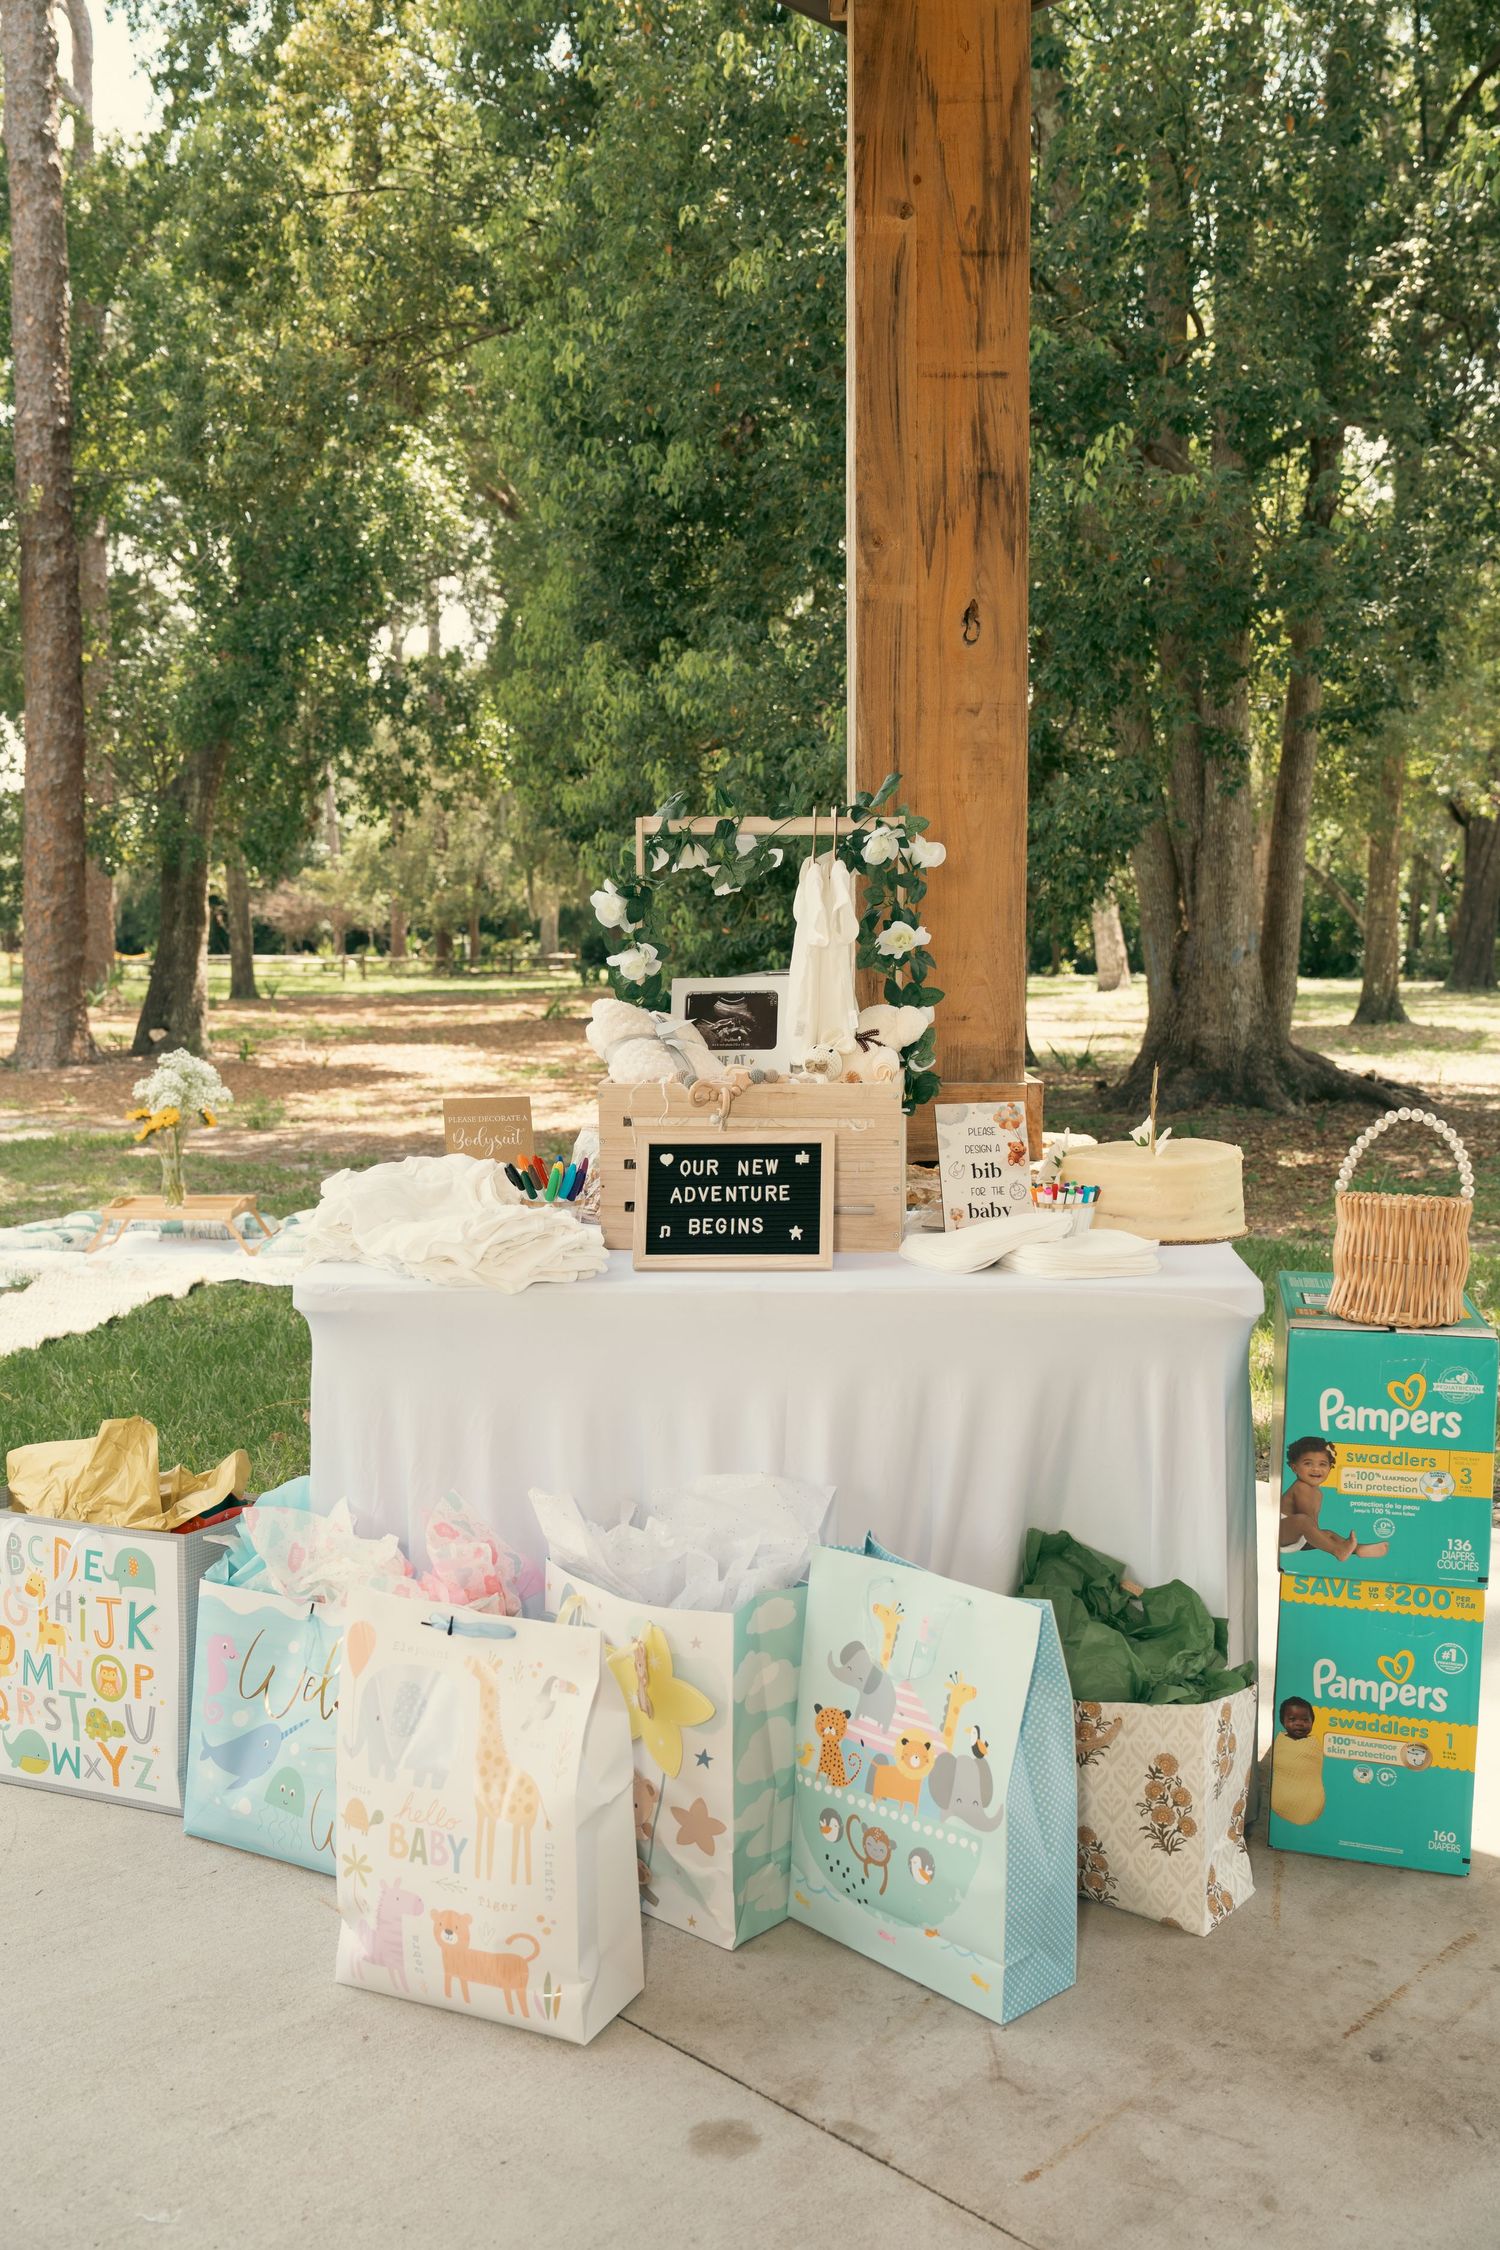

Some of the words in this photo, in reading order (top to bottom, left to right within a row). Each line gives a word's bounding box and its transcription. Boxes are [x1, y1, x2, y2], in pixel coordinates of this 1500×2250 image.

[448, 1115, 477, 1123] PLEASE
[478, 1115, 520, 1123] DECORATE
[967, 1127, 996, 1137] PLEASE
[452, 1125, 526, 1157] Bodysuit
[964, 1145, 992, 1155] DESIGN
[995, 1145, 1000, 1153] A
[679, 1159, 719, 1177] OUR
[737, 1158, 779, 1177] NEW
[971, 1162, 1002, 1179] bib
[669, 1184, 791, 1204] ADVENTURE
[970, 1186, 986, 1197] FOR
[991, 1186, 1005, 1197] THE
[967, 1202, 1012, 1219] baby
[688, 1217, 764, 1236] BEGINS
[1435, 1384, 1482, 1393] PEDIATRICIAN
[1319, 1387, 1463, 1440] Pampers
[1346, 1450, 1437, 1468] swaddlers
[1355, 1470, 1381, 1482] 100%
[1381, 1475, 1418, 1483] LEAKPROOF
[1460, 1468, 1473, 1485] 3
[1343, 1480, 1363, 1490] skin
[1365, 1482, 1418, 1494] protection
[1349, 1500, 1384, 1508] protection
[1447, 1538, 1472, 1551] 136
[1441, 1550, 1476, 1563] DIAPERS
[1436, 1559, 1480, 1572] COUCHES
[1293, 1575, 1362, 1601] SAVE
[1368, 1592, 1379, 1600] TO
[1455, 1595, 1471, 1603] PER
[1455, 1601, 1476, 1610] YEAR
[1441, 1648, 1457, 1661] #1
[1313, 1658, 1449, 1713] Pampers
[1328, 1716, 1429, 1739] swaddlers
[1331, 1735, 1357, 1746] 100%
[1357, 1741, 1398, 1752] LEAKPROOF
[1446, 1732, 1454, 1750] 1
[1326, 1745, 1346, 1755] skin
[1348, 1750, 1398, 1762] protection
[394, 1791, 463, 1831] hello
[1433, 1830, 1457, 1843] 160
[388, 1822, 469, 1875] BABY
[1428, 1840, 1461, 1854] DIAPERS
[544, 1842, 556, 1902] Giraffe
[477, 1896, 519, 1912] Tiger
